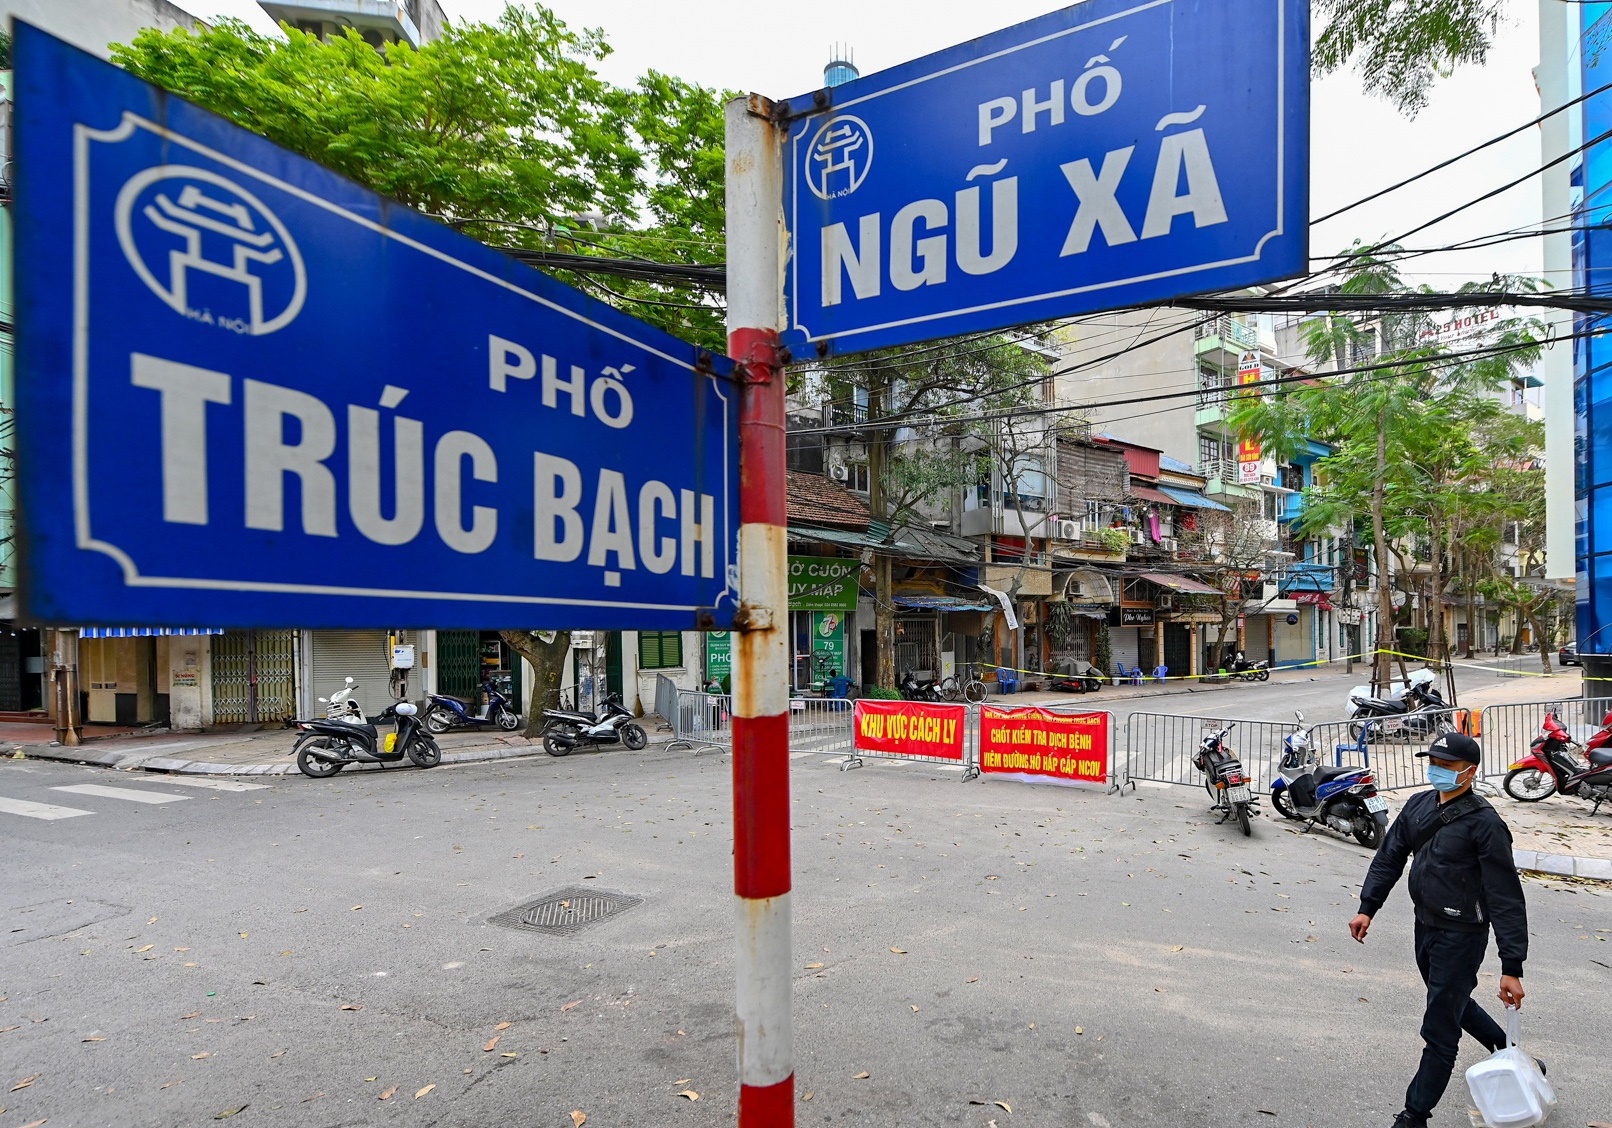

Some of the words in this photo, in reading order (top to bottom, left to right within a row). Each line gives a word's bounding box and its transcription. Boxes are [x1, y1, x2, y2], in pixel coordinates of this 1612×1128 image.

[978, 35, 1128, 146] PHỐ
[821, 158, 1018, 307] NGŨ
[1059, 104, 1229, 257] XÃ
[1454, 310, 1499, 330] HOTEL
[489, 334, 635, 429] PHỐ
[131, 352, 498, 554] TRÚC
[533, 451, 714, 587] BẠCH
[1244, 463, 1255, 472] 89
[823, 641, 835, 650] 79
[861, 713, 884, 738] KHU
[886, 713, 908, 744] VỰC
[909, 711, 941, 743] CÁCH
[943, 718, 956, 744] LY
[991, 724, 1010, 744] CHỐT
[1012, 724, 1031, 744] KIỂM
[1033, 730, 1047, 746] TRA
[1049, 731, 1067, 750] DỊCH
[1069, 731, 1092, 752] BỆNH
[984, 750, 1001, 767] VIÊM
[1003, 750, 1029, 769] ĐƯỜNG
[1030, 752, 1041, 770] HÔ
[1043, 752, 1058, 771] HẤP
[1060, 754, 1077, 774] CẤP
[1078, 759, 1100, 777] NCOV
